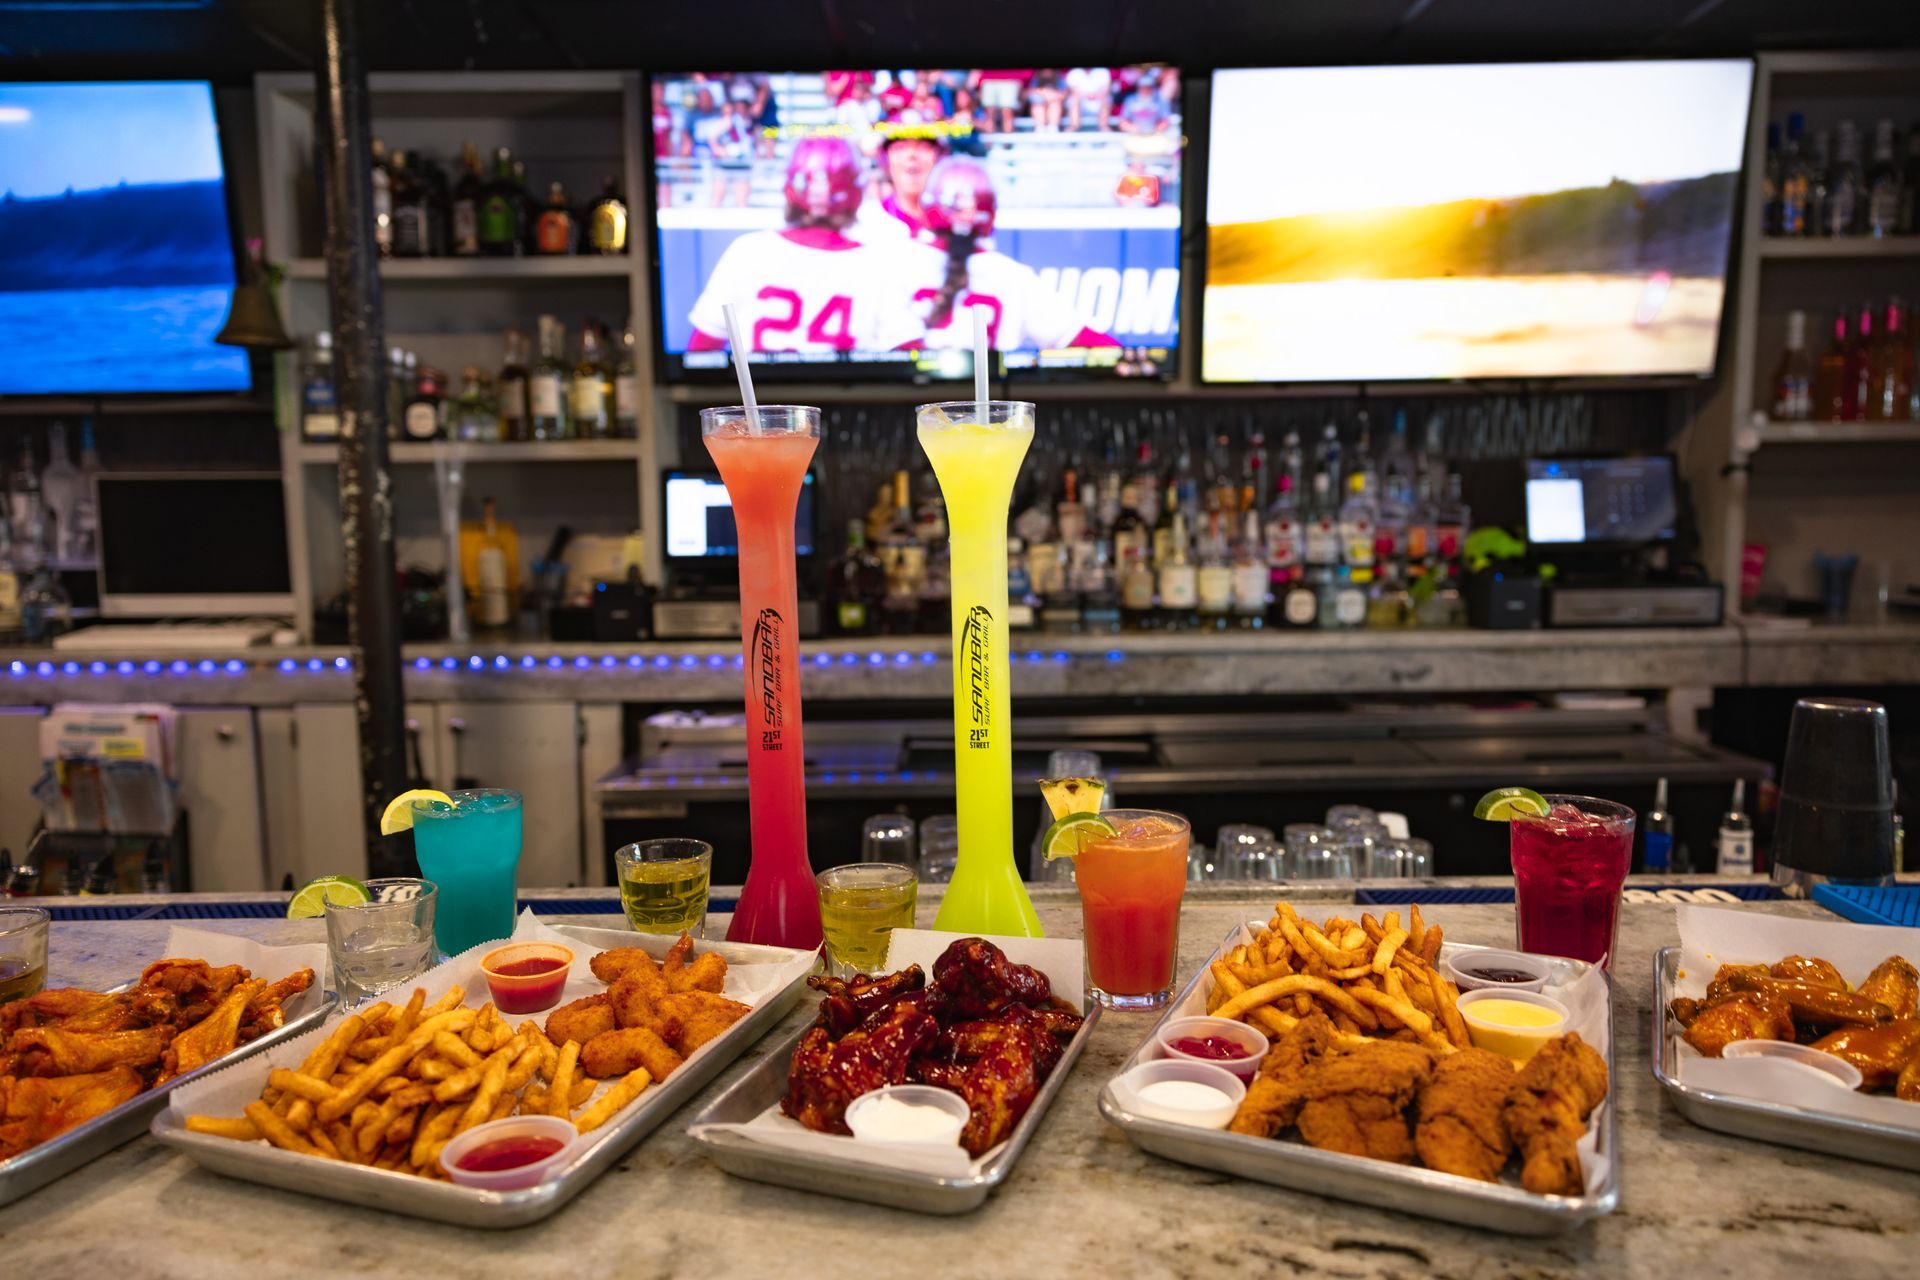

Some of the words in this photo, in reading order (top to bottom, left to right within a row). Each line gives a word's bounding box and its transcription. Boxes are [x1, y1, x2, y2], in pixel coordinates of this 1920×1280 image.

[753, 285, 856, 352] 24
[774, 618, 782, 650] GRILL
[775, 655, 781, 663] &
[983, 653, 989, 662] &
[760, 609, 776, 728] SANDBAR
[970, 606, 983, 727] SANDBAR
[762, 730, 781, 743] 21ST
[970, 729, 989, 741] 21ST
[762, 743, 783, 751] STREET
[969, 741, 990, 749] STREET
